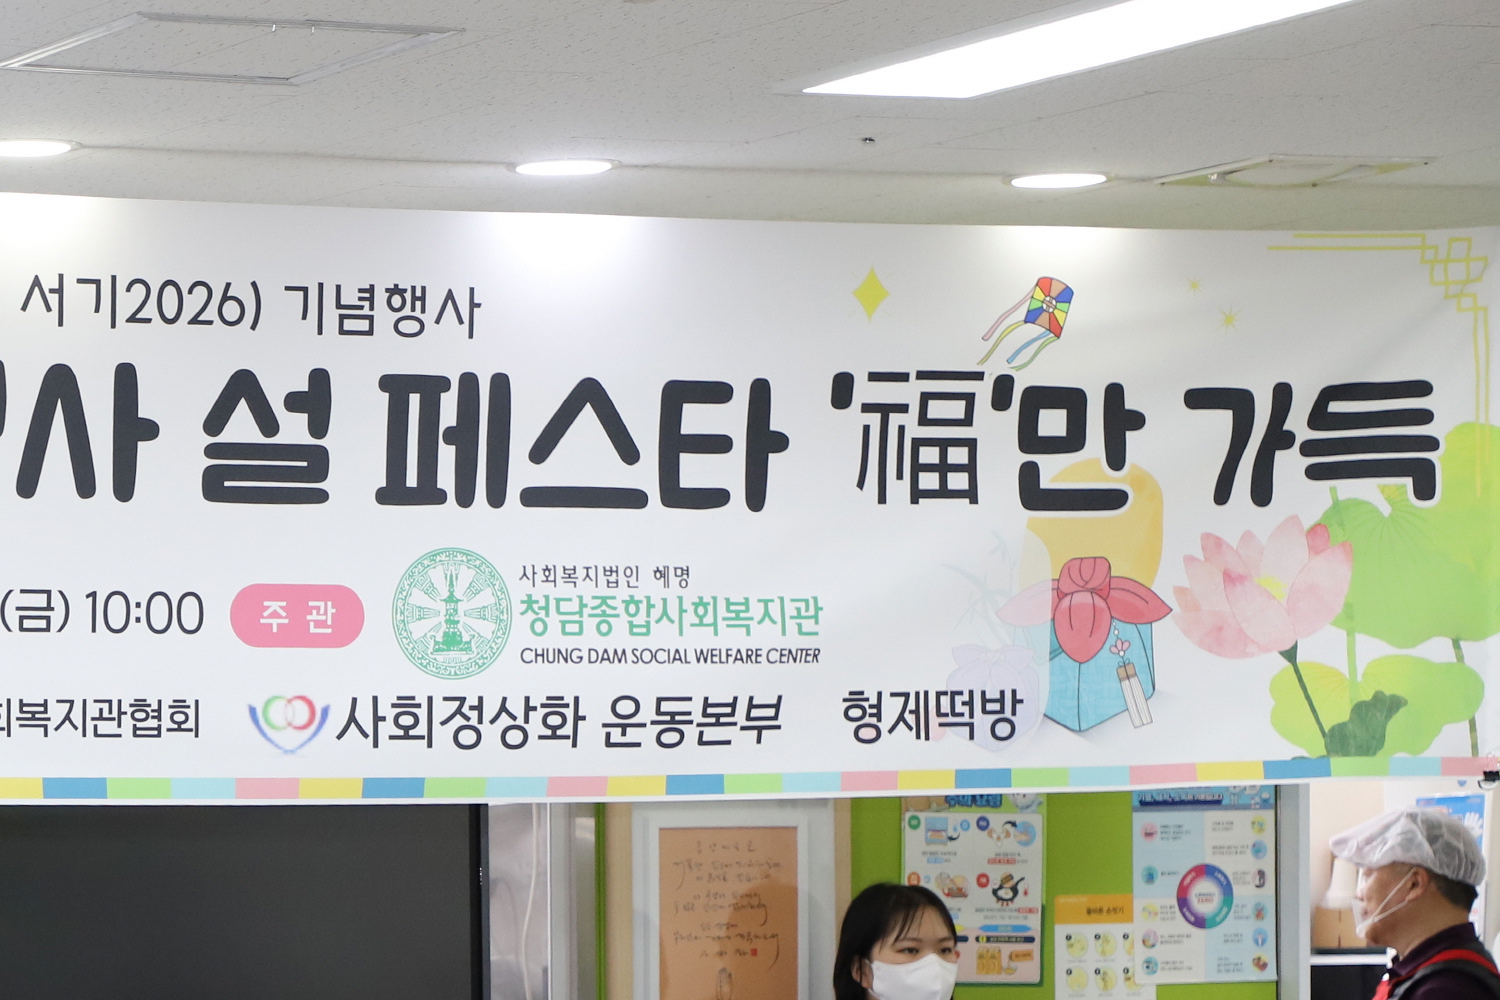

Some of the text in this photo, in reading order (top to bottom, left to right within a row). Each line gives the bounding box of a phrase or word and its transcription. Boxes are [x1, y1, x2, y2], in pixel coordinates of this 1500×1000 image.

[21, 274, 261, 331] 서기2026)
[285, 283, 481, 339] 기념행사
[202, 369, 331, 504] 설
[376, 373, 789, 512] 페스타
[1184, 380, 1439, 507] 가득
[520, 565, 689, 588] 사회복지법인 혜명
[86, 591, 203, 634] 10:00
[522, 595, 823, 636] 청담종합사회복지관
[521, 648, 820, 664] CHUNG DAM SOCIAL WELFARE CENTER
[336, 695, 782, 750] 사회정상화 운동본부
[843, 689, 1023, 744] 형제떡방
